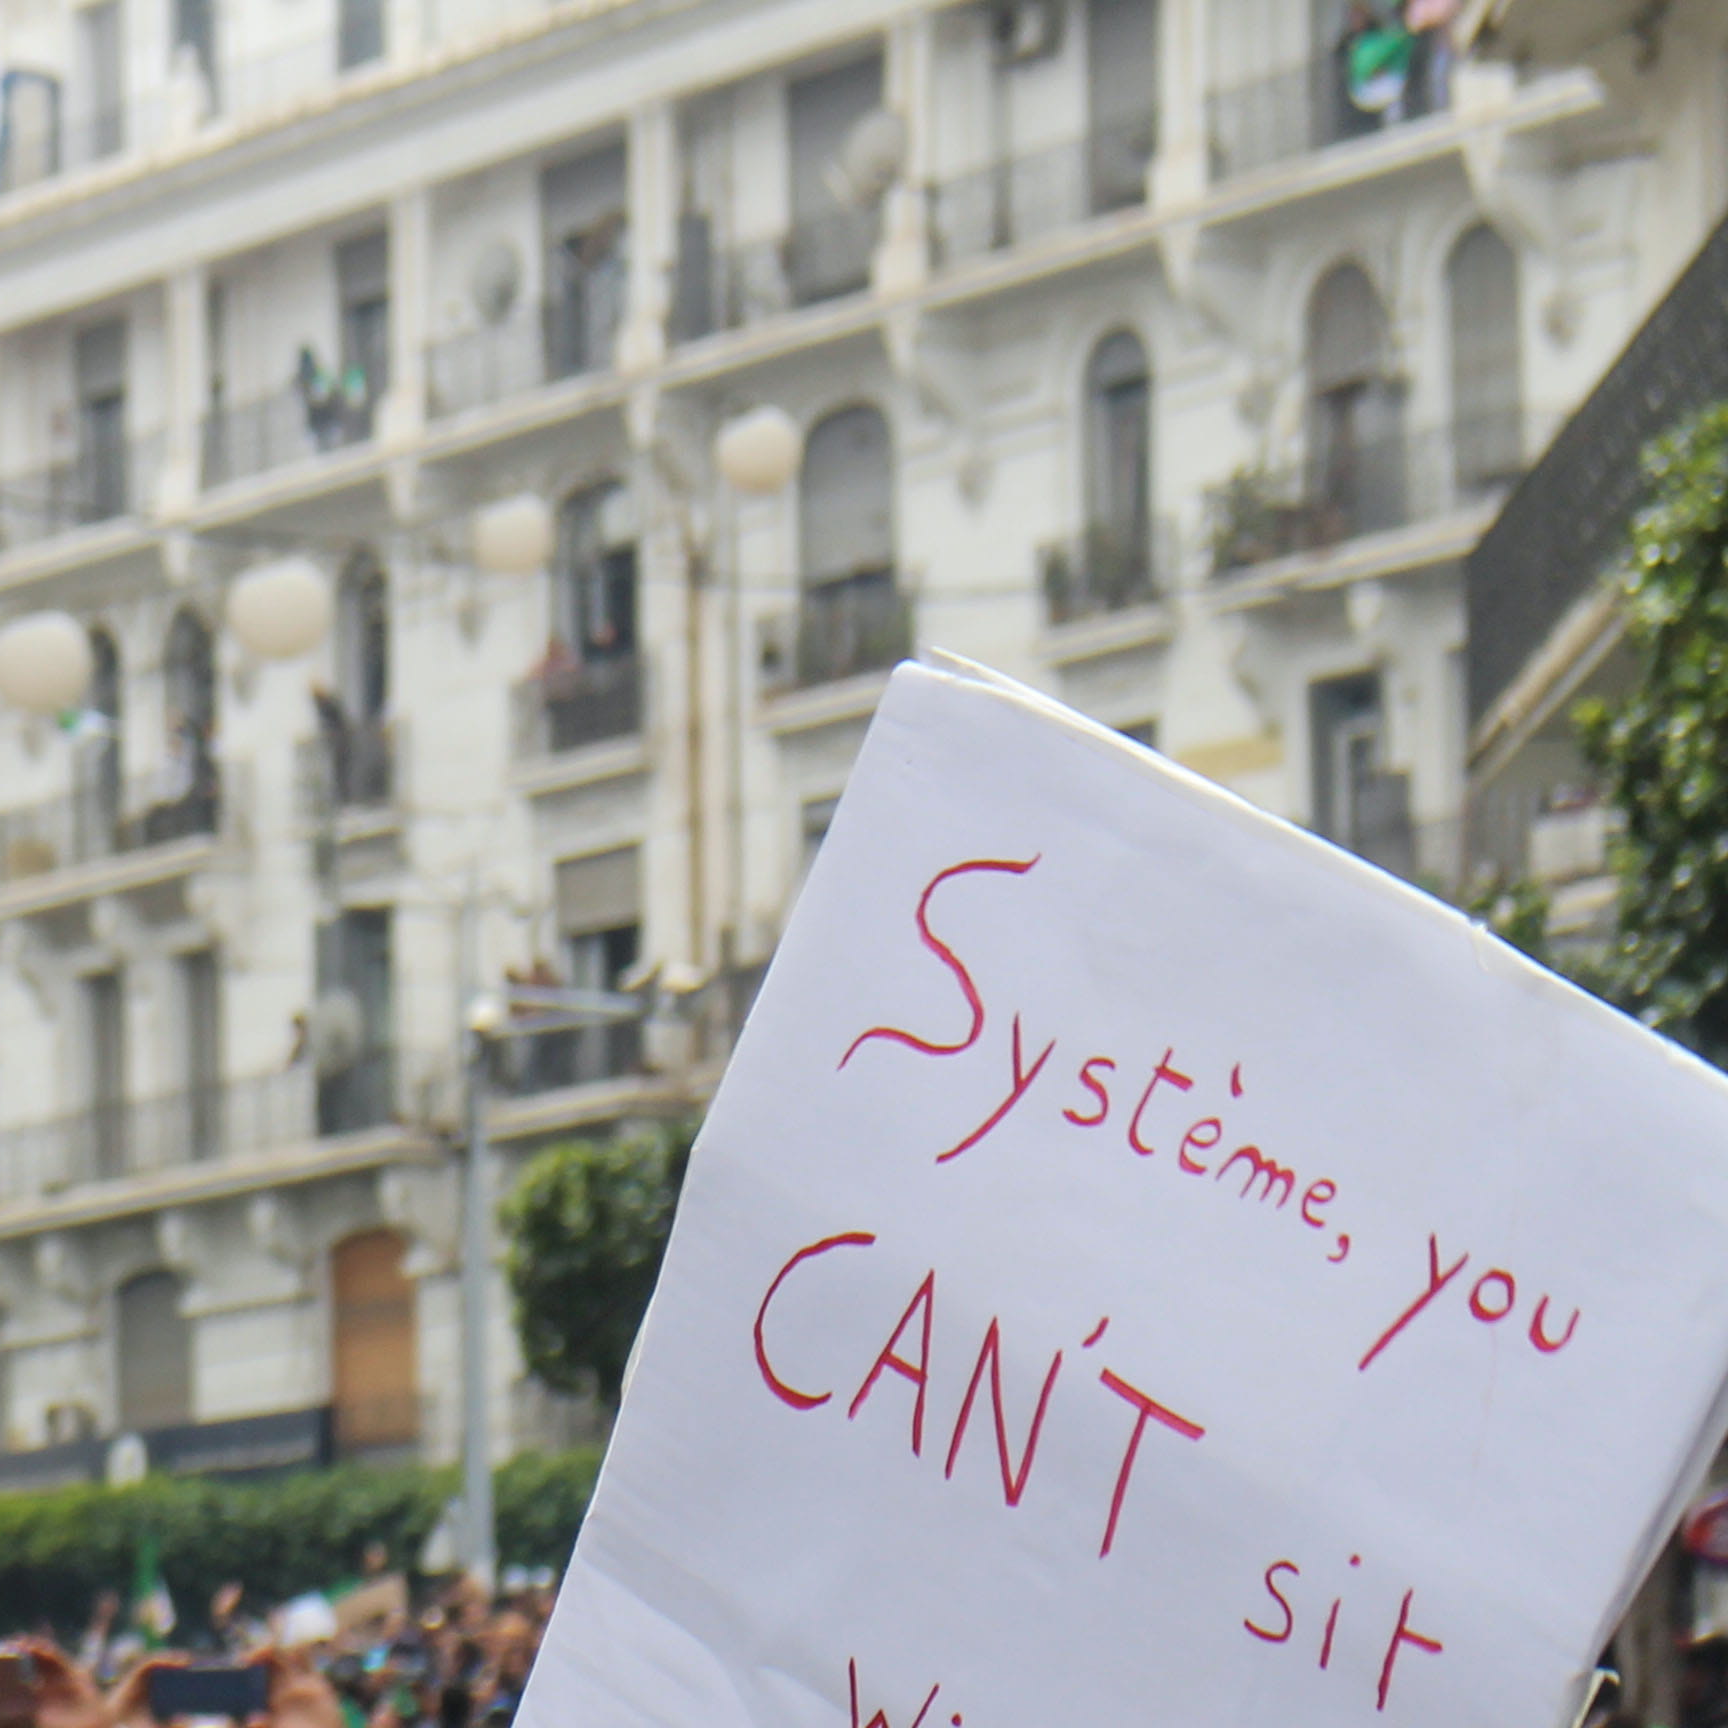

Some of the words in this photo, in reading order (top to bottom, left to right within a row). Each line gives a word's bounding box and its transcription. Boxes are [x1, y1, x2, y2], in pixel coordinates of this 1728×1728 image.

[1360, 1234, 1579, 1371] you
[754, 1232, 1205, 1559] CAN'T
[1243, 1555, 1442, 1711] sit
